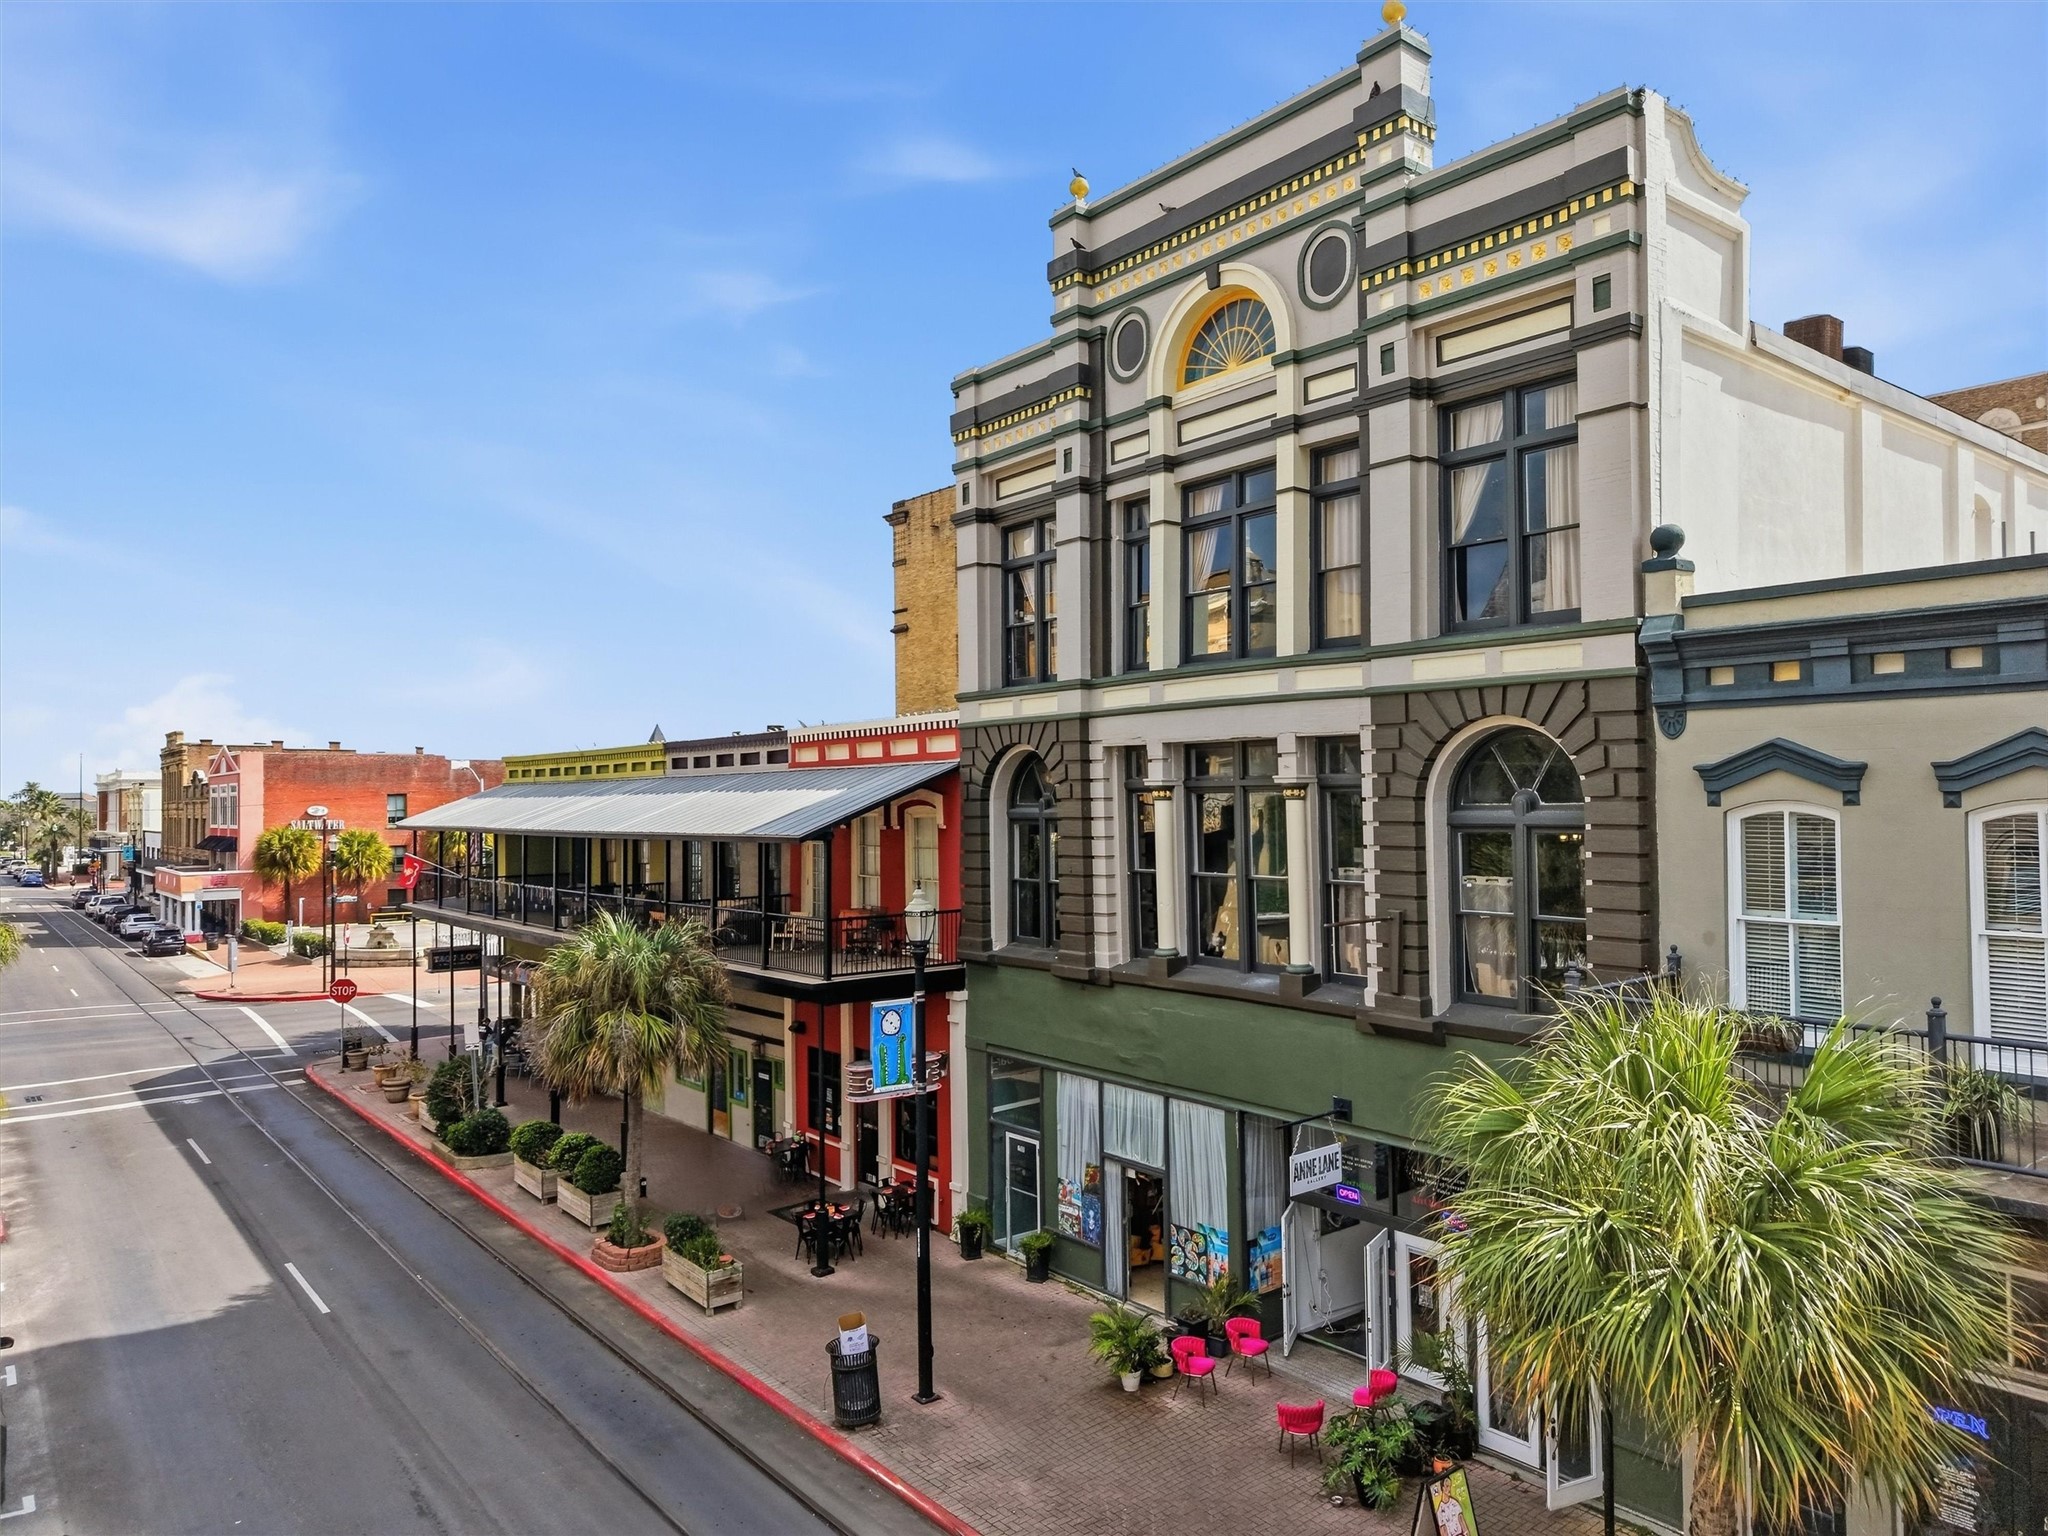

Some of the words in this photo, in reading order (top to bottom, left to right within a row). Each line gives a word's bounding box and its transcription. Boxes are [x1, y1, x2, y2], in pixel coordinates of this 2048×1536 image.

[331, 985, 356, 996] STOP
[1293, 1157, 1318, 1183] ANNE
[1318, 1151, 1340, 1175] LANE
[1307, 1175, 1327, 1185] GALLERY
[1339, 1187, 1359, 1201] OPEN
